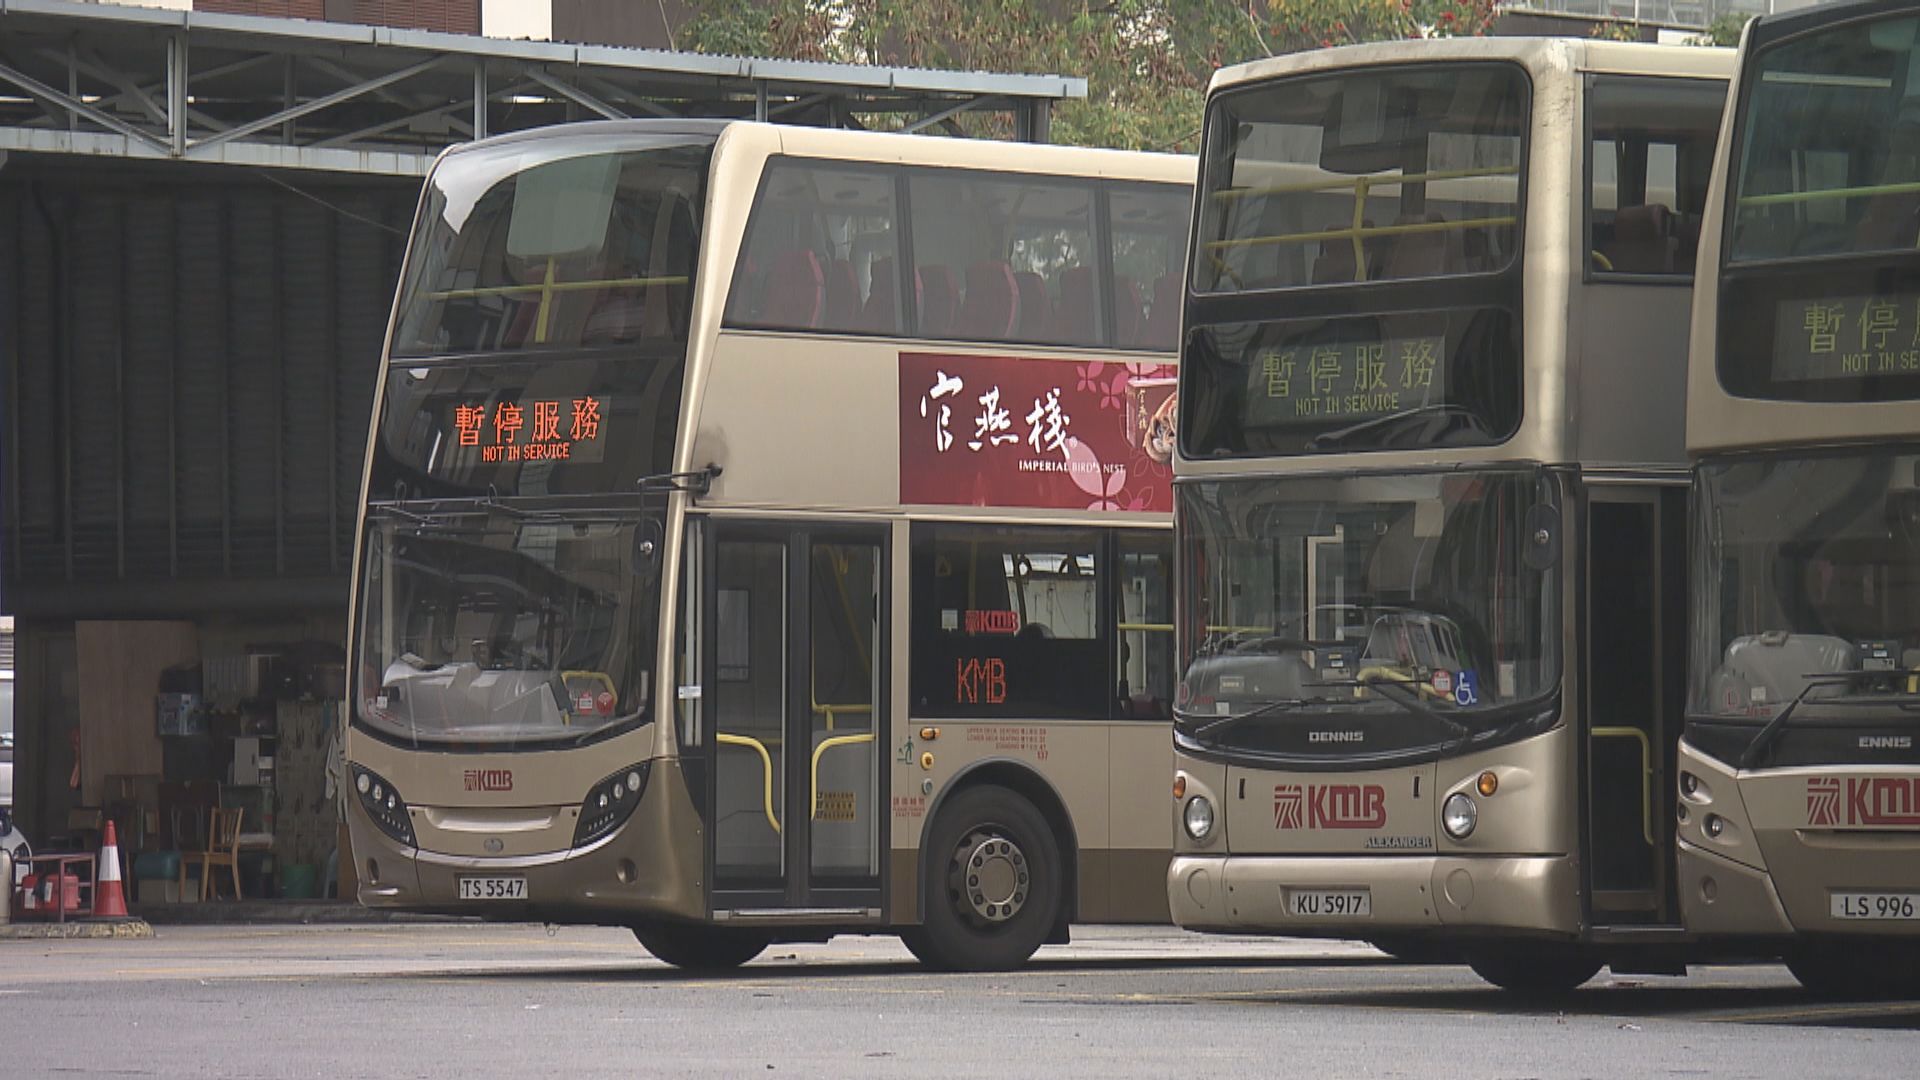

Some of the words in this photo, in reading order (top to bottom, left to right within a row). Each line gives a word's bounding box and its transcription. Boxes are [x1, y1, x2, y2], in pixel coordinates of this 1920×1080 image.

[1804, 298, 1920, 353] 暫停
[1262, 340, 1436, 398] 暫停服務
[1842, 353, 1871, 373] NOT
[1878, 352, 1894, 371] IN
[1295, 398, 1320, 416] NOT
[1326, 397, 1340, 415] IN
[1344, 392, 1399, 413] SERVICE
[455, 396, 601, 447] 暫停服務
[482, 445, 504, 462] NOT
[507, 444, 521, 461] IN
[523, 442, 570, 460] SERVICE
[1018, 459, 1068, 472] IMPERIAL
[1072, 461, 1101, 474] BIRD'S
[1103, 463, 1125, 475] NEST
[979, 610, 1019, 632] KMB
[957, 658, 1007, 703] KMB
[1309, 731, 1364, 743] DENNIS
[1858, 736, 1912, 748] ENNIS
[476, 770, 513, 791] KMB
[1308, 785, 1386, 829] KMB
[1847, 778, 1920, 825] KM
[1364, 837, 1432, 849] ALEXANDER
[462, 879, 482, 897] TS
[485, 879, 524, 897] 5547
[1296, 896, 1319, 914] KU
[1323, 896, 1363, 915] 5917
[1844, 896, 1869, 917] LS
[1876, 896, 1914, 918] 996
